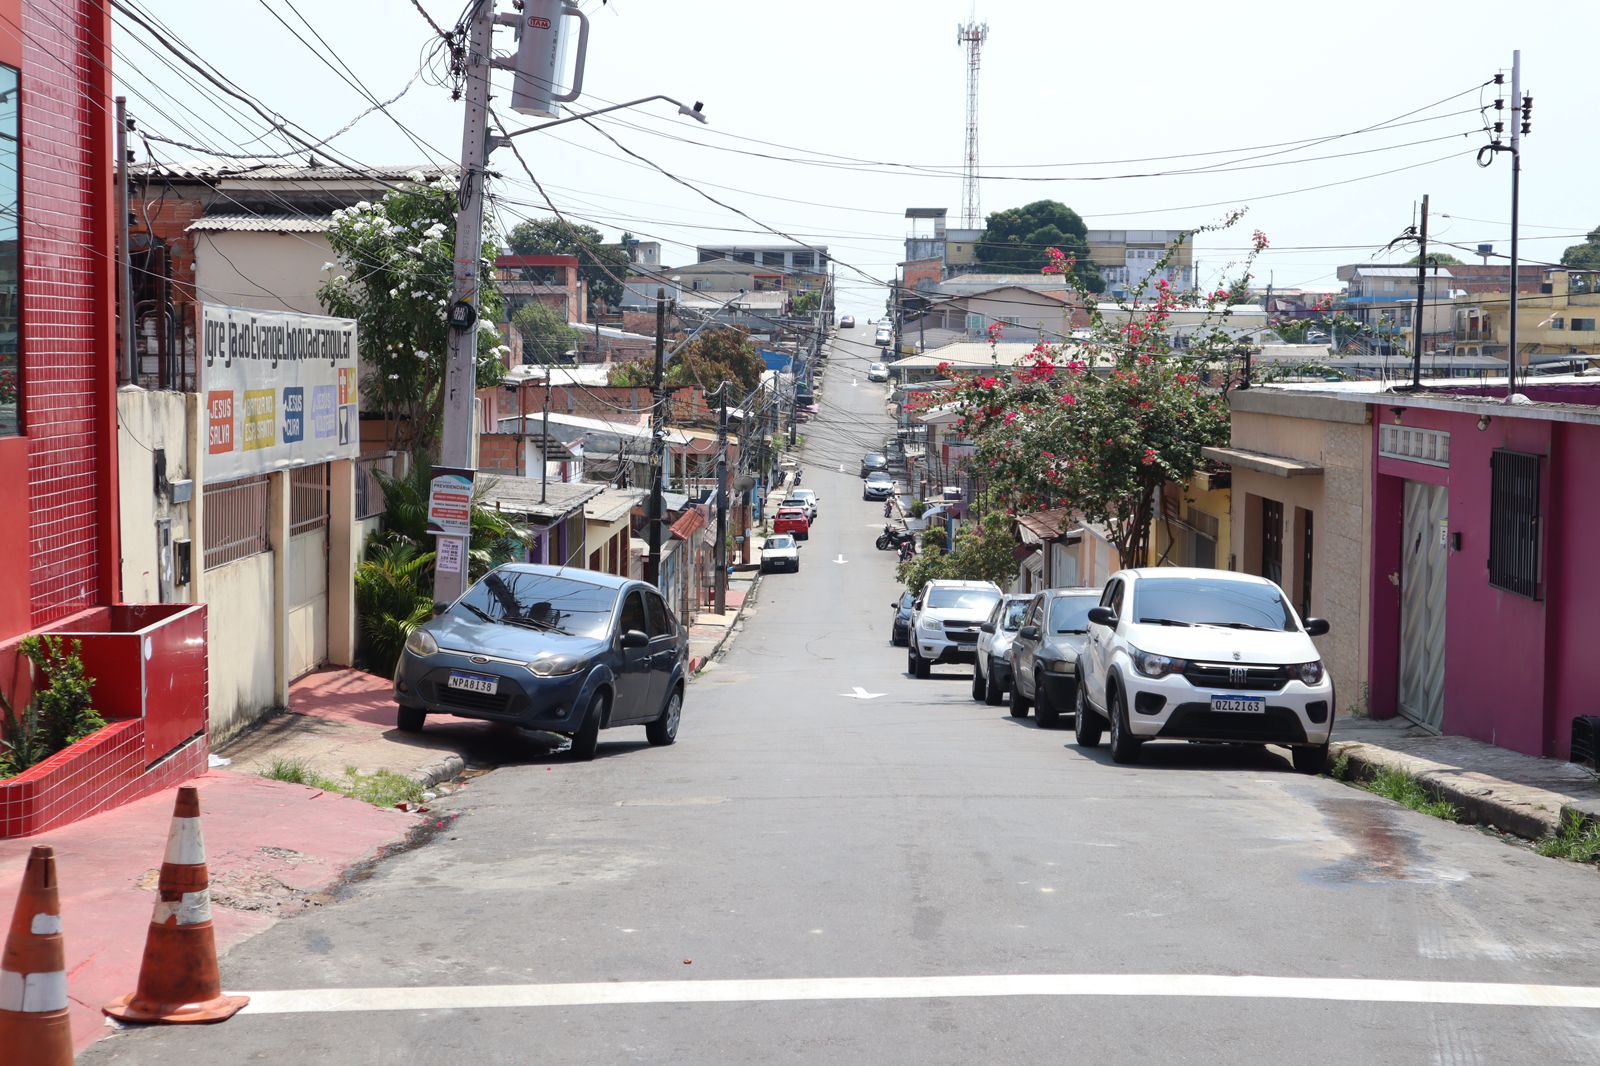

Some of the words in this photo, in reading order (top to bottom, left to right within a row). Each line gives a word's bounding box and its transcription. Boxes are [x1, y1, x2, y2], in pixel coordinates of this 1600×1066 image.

[204, 311, 237, 368] igreja
[239, 323, 250, 358] do
[210, 399, 231, 419] JESUS
[287, 395, 302, 412] JESUS
[315, 392, 332, 410] JESUS
[209, 424, 230, 445] SALVA
[257, 419, 274, 439] SANTO
[287, 418, 300, 436] CURA
[1229, 667, 1249, 683] FIAT
